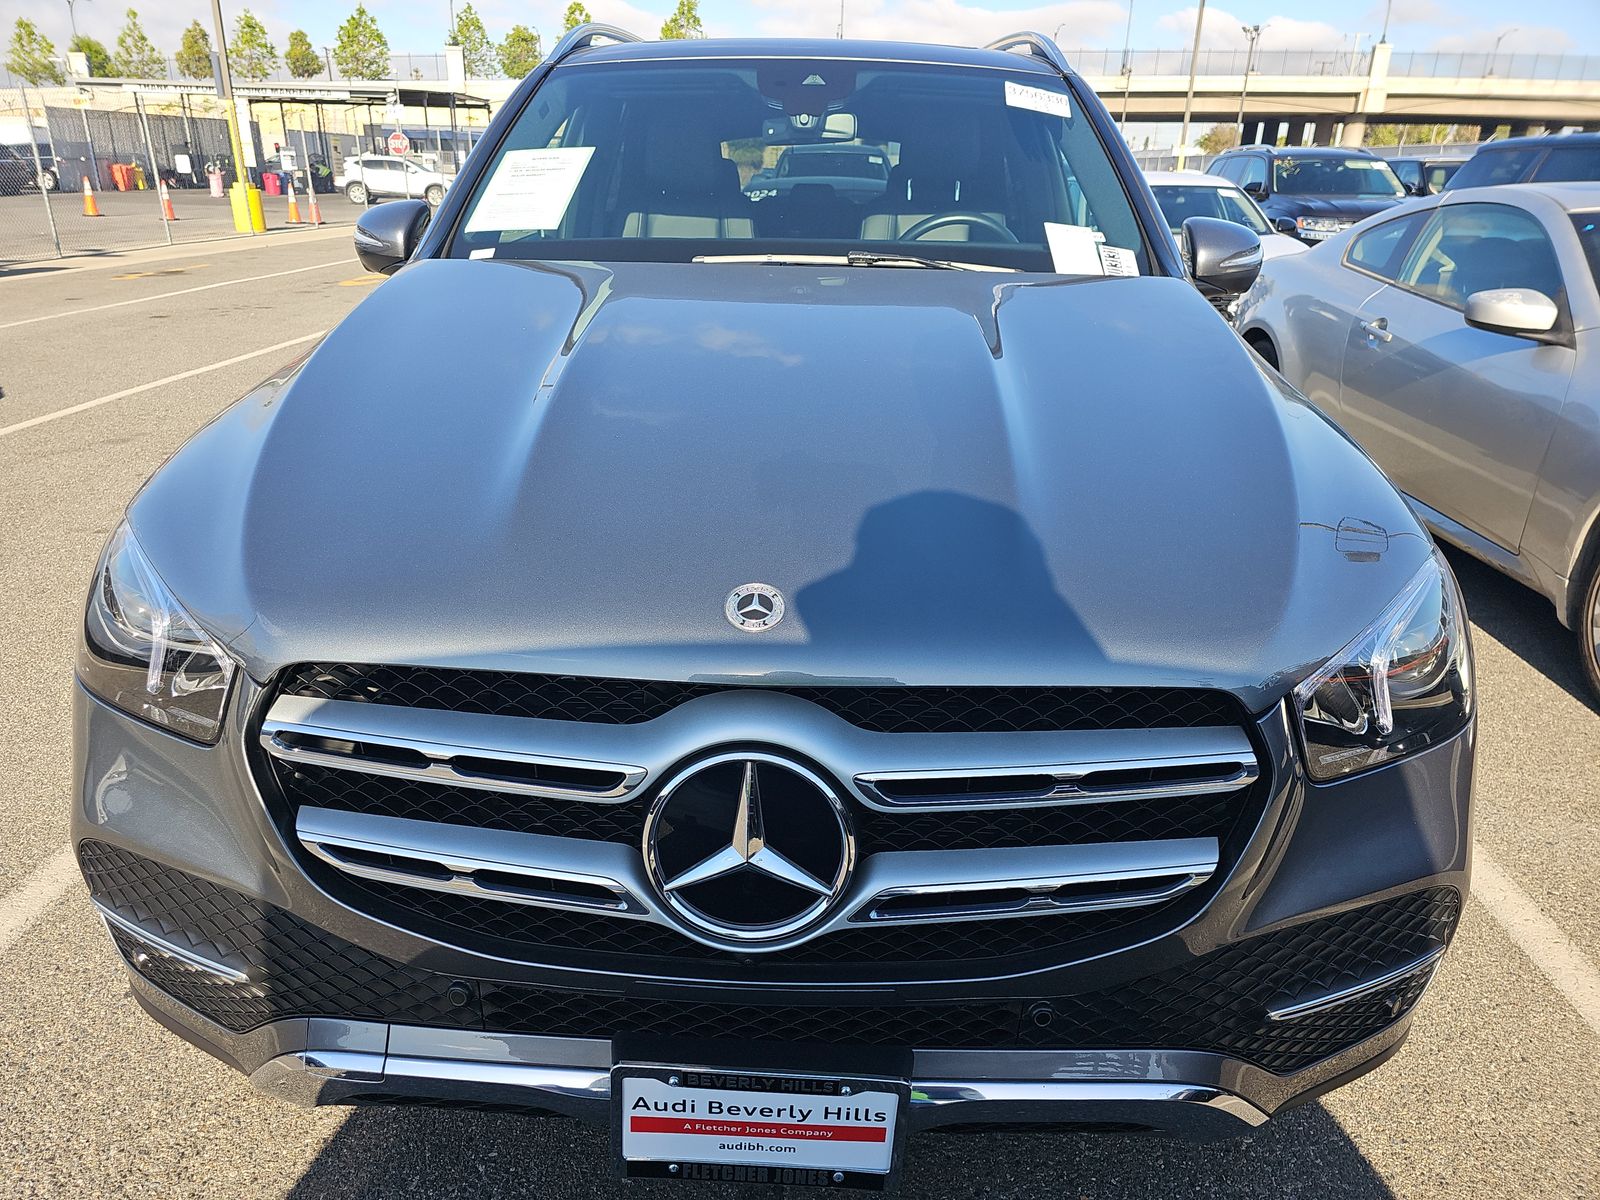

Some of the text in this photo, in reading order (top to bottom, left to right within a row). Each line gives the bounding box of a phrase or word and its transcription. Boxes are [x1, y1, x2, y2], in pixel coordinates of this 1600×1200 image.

[389, 140, 408, 149] STOP
[687, 1073, 834, 1093] BEVERLY HILLS
[631, 1096, 887, 1123] Audi Beverly Hills
[695, 1123, 742, 1132] Fletcher
[745, 1126, 777, 1134] Jones
[780, 1127, 833, 1138] Company
[718, 1142, 796, 1154] audibh.com
[682, 1163, 829, 1186] FLETCHER JONES
